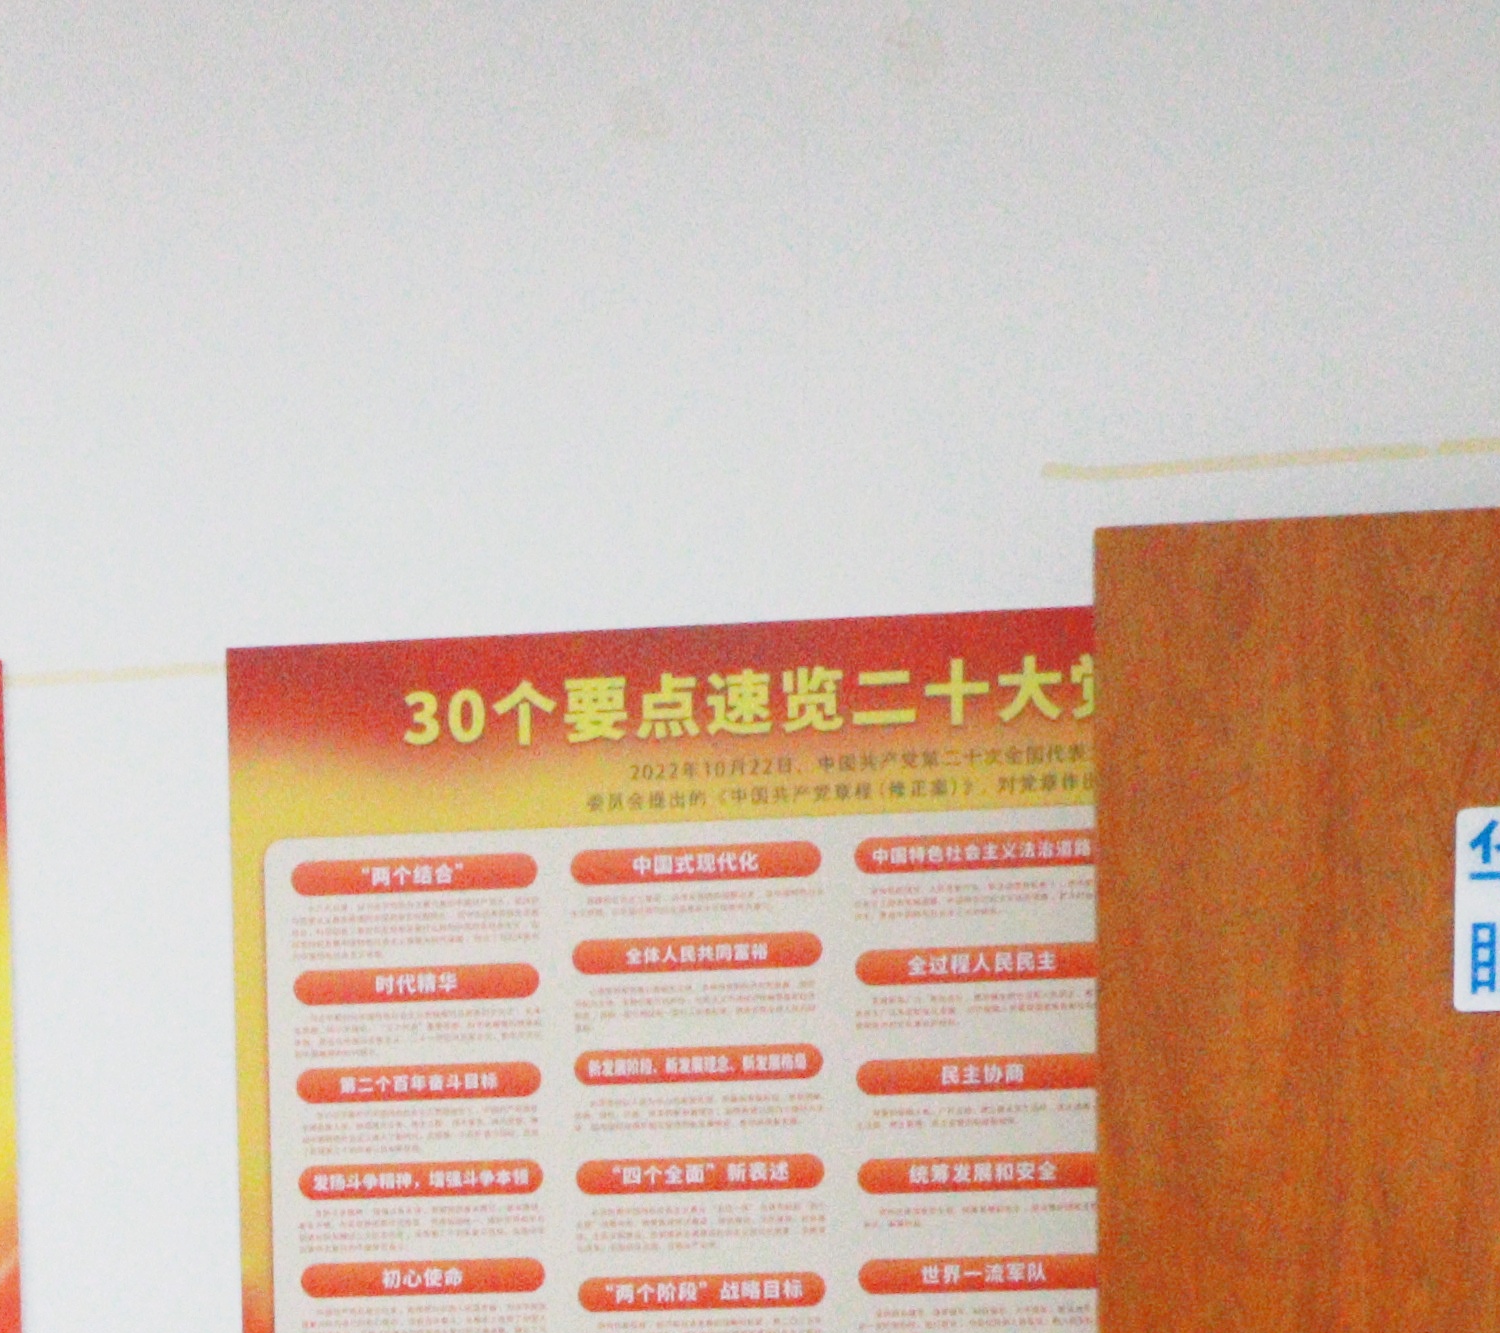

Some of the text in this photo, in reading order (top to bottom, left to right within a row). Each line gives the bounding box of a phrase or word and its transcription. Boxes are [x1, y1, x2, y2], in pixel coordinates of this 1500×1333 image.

[873, 838, 1092, 865] 中国特色社会主义法治道路
[362, 862, 464, 887] “两个结合”
[633, 852, 759, 876] 中国式现代化
[626, 943, 768, 965] 全体人民共同富裕
[908, 952, 1057, 976] 全过程人民民主
[374, 972, 458, 995] 时代精华
[340, 1072, 498, 1094] 第二个百年奋斗目标
[941, 1063, 1025, 1086] 民主协商
[909, 1160, 1058, 1185] 统筹发展和安全
[382, 1267, 464, 1289] 初心使命
[921, 1262, 1047, 1285] 世界一流军队
